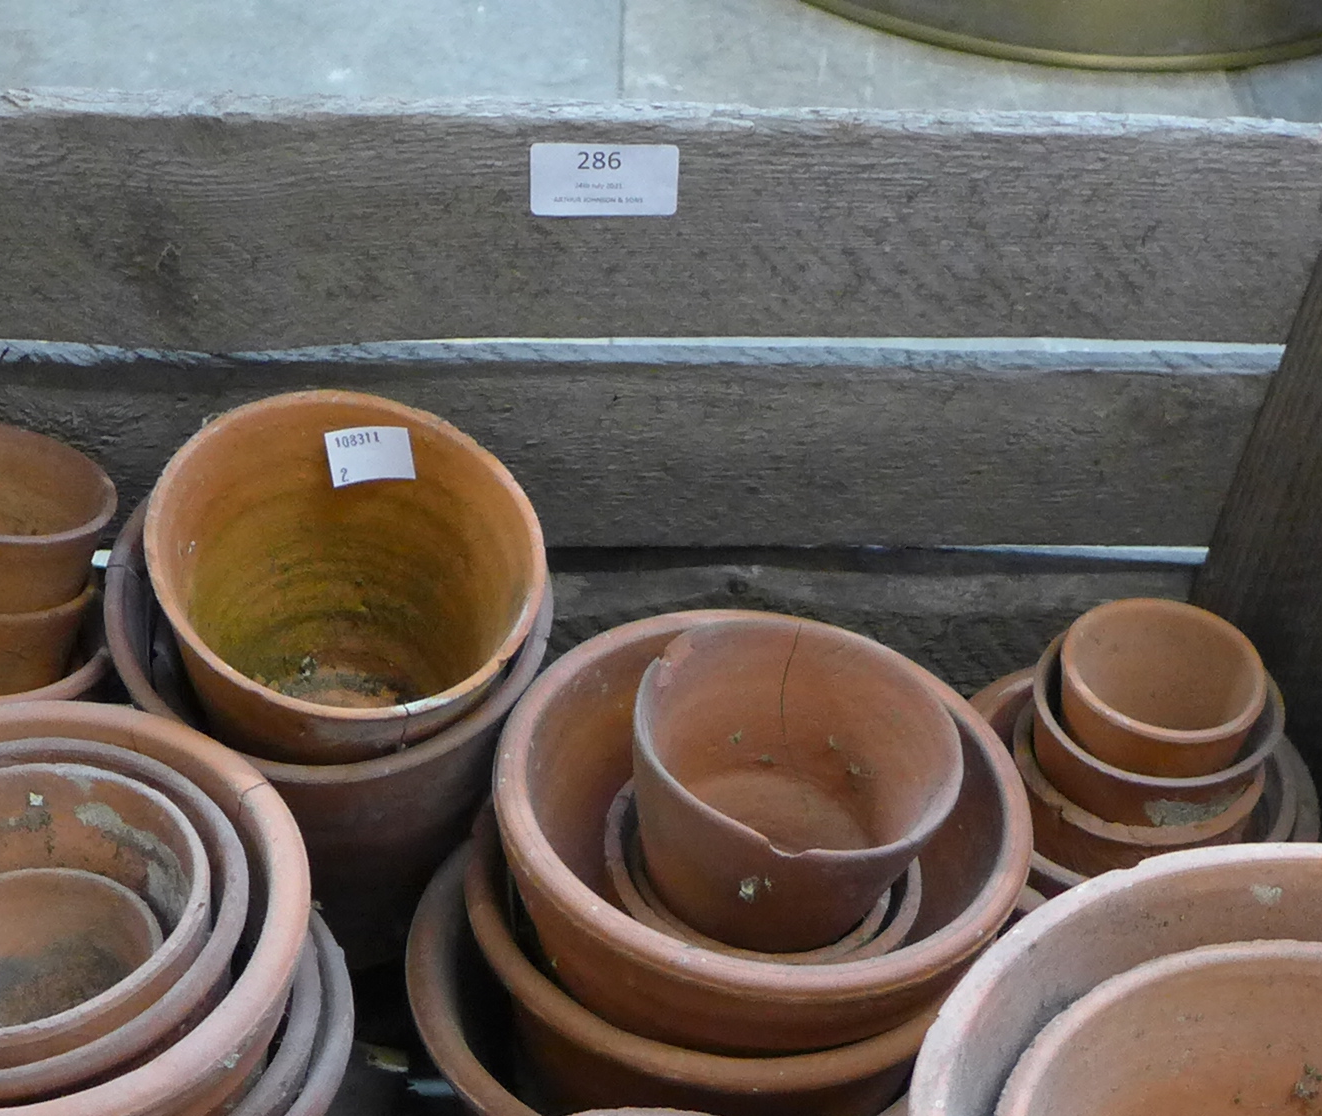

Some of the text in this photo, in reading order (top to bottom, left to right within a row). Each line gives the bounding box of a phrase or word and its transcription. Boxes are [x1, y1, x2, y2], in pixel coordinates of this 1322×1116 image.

[577, 151, 622, 170] 286
[334, 431, 380, 449] 108311
[340, 467, 349, 482] 2
